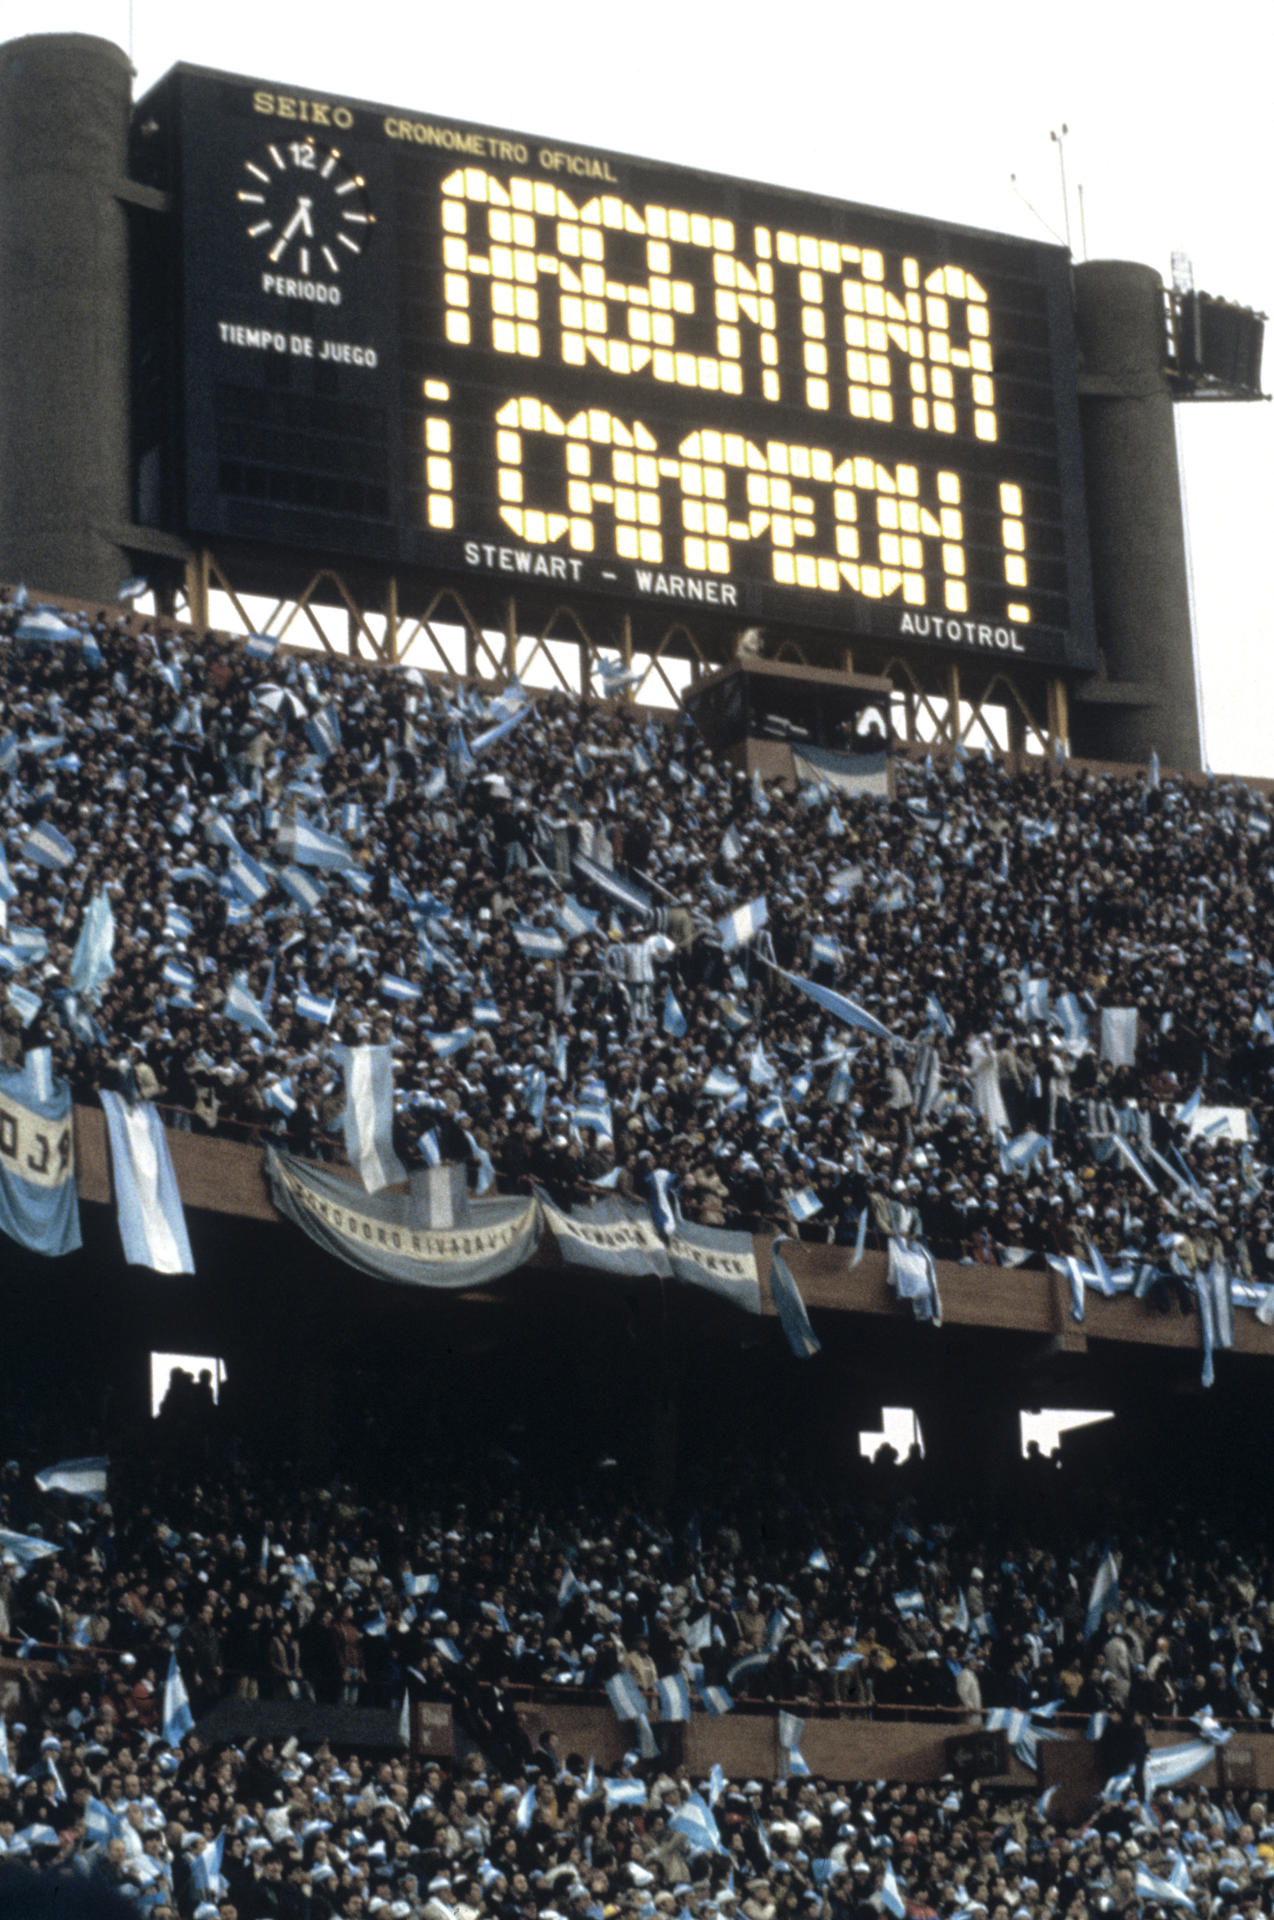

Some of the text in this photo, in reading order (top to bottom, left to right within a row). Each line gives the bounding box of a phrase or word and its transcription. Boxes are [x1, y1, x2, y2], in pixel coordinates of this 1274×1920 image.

[253, 91, 354, 130] SEIKO
[291, 142, 317, 170] 12
[384, 117, 618, 184] CRONOMETRO OFICIAL
[262, 273, 342, 305] PERIODO
[441, 167, 998, 443] ARGENTINA
[218, 321, 378, 368] TIEMPO DE JUEGO
[464, 543, 584, 582] STEWART
[635, 569, 738, 608] WARNER
[899, 612, 1027, 653] AUTOTROL
